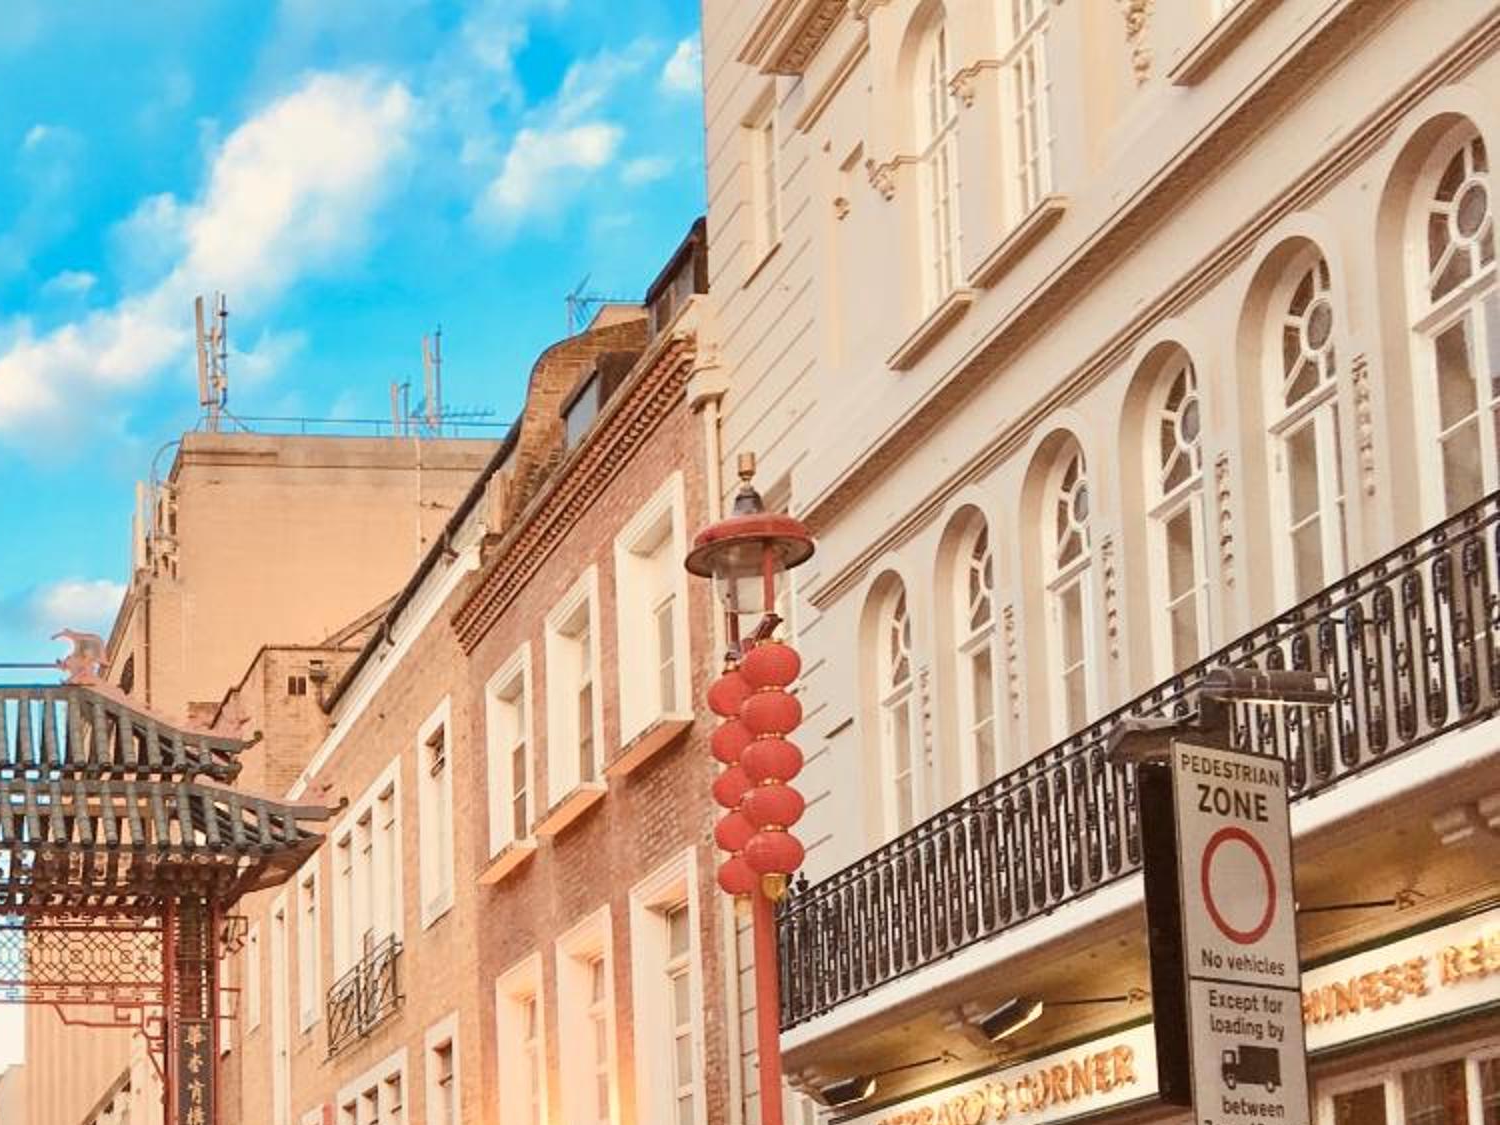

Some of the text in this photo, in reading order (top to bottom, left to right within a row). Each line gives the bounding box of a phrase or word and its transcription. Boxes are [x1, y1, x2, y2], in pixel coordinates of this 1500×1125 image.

[1181, 753, 1281, 788] PEDESTRIAN
[1197, 783, 1269, 822] ZONE
[1201, 948, 1285, 976] No vehicles
[1208, 989, 1283, 1014] Except for
[1209, 1013, 1285, 1042] loading by
[1015, 1044, 1138, 1114] CORNER
[1222, 1096, 1285, 1118] between
